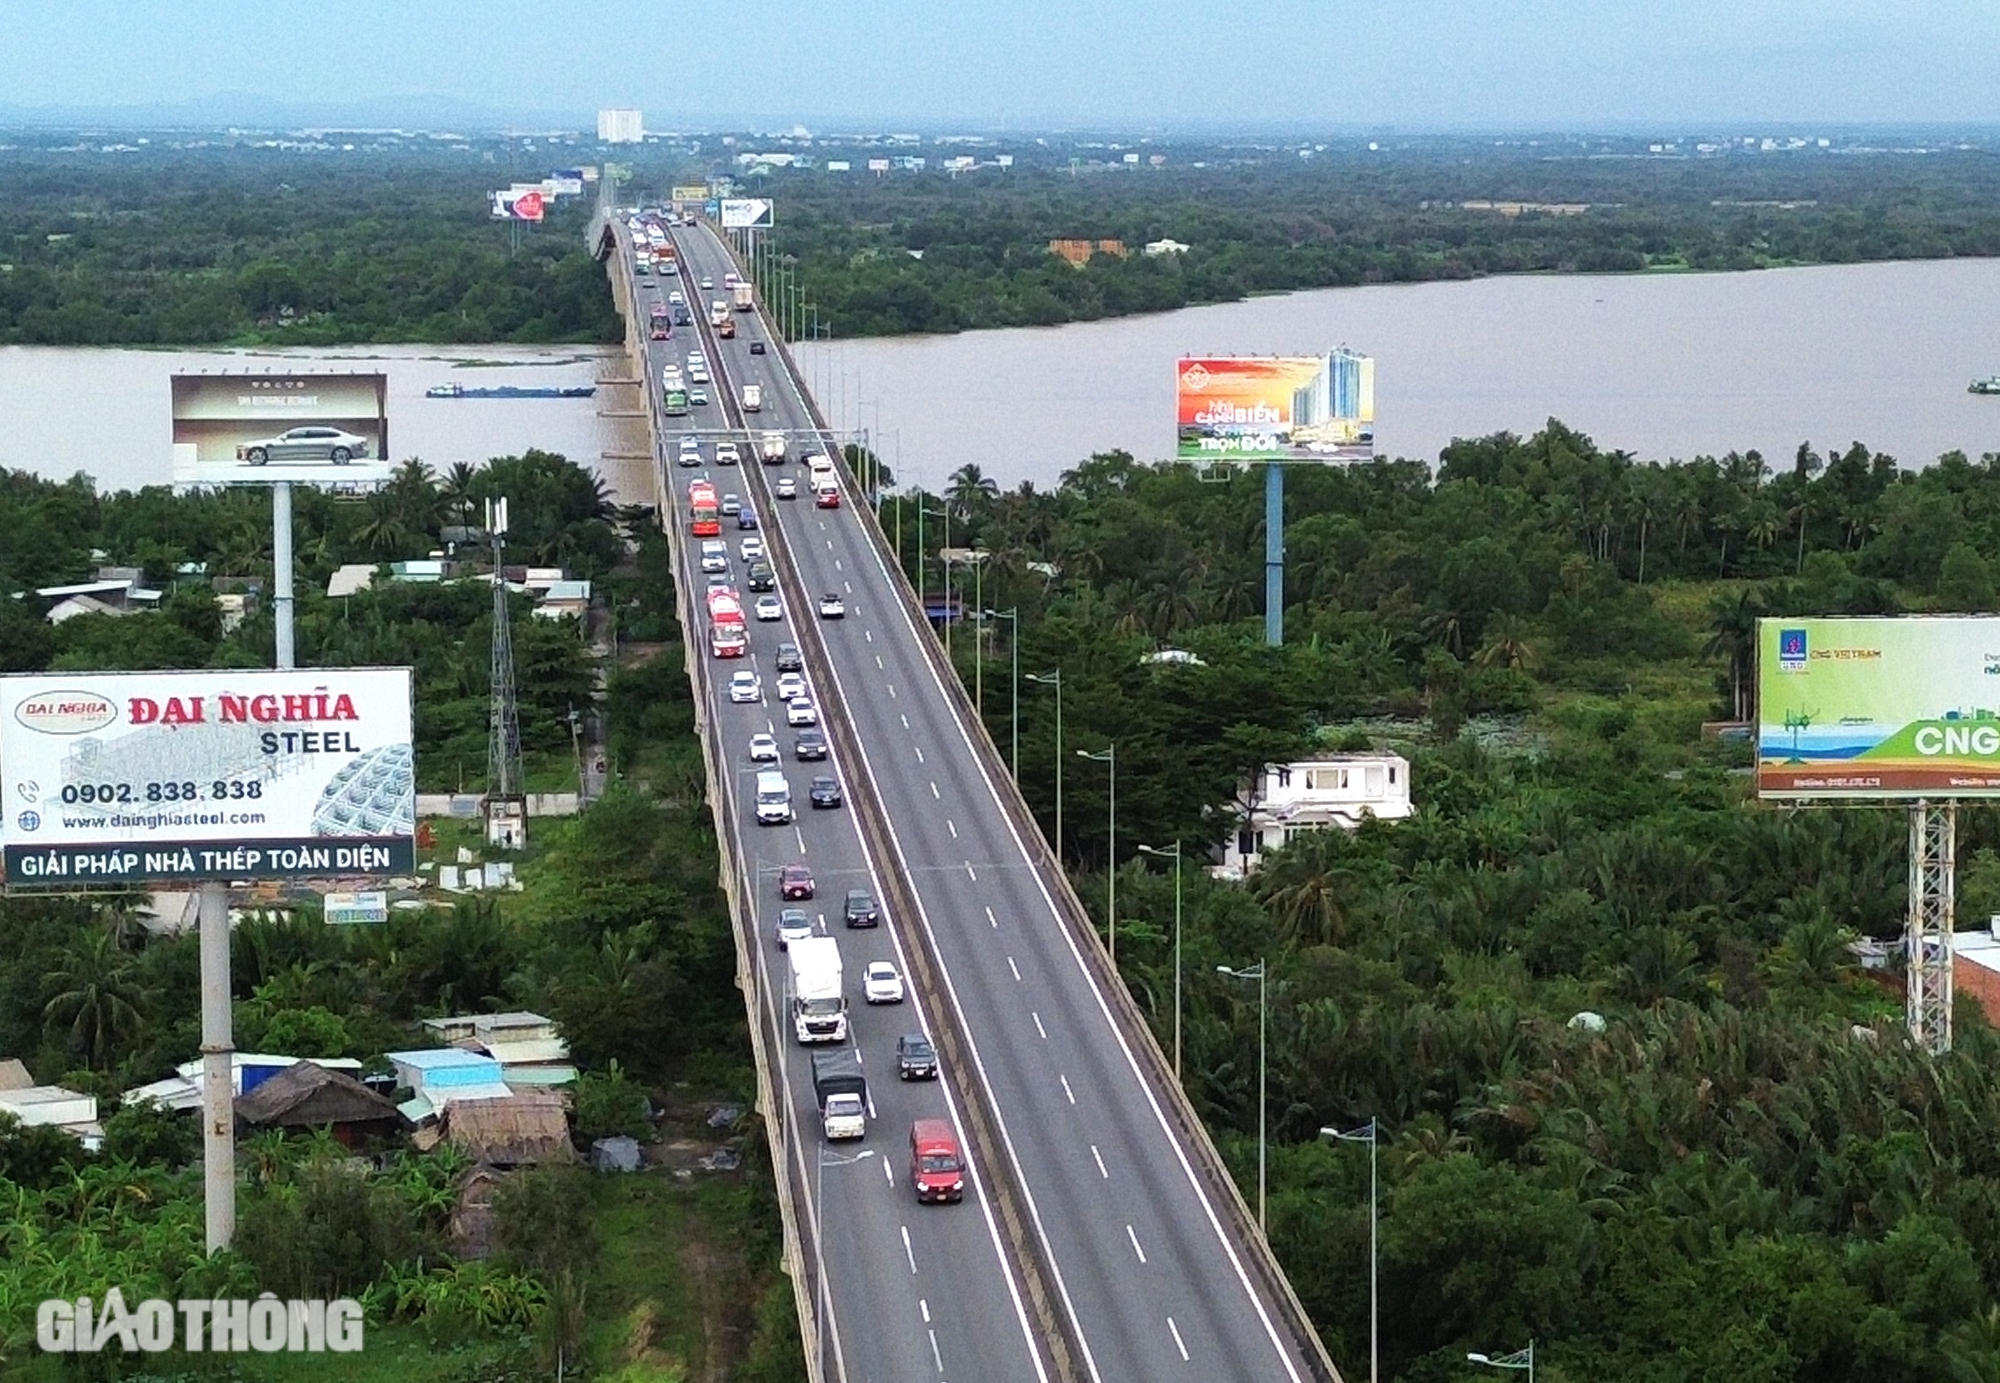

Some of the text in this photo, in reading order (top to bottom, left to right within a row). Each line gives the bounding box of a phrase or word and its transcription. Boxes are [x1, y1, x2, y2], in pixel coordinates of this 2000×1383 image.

[128, 685, 360, 731] ĐẠI NGHĨA
[260, 731, 361, 754] STEEL
[1915, 726, 2000, 755] CNG
[61, 783, 140, 804] 0902.
[211, 780, 263, 800] 838
[62, 811, 267, 830] www.dainghiasteel.com
[20, 848, 68, 876] GIẢI
[74, 849, 138, 875] PHÁP
[145, 848, 196, 873] NHÀ
[266, 845, 330, 869] TOÀN
[336, 843, 390, 872] DIỆN
